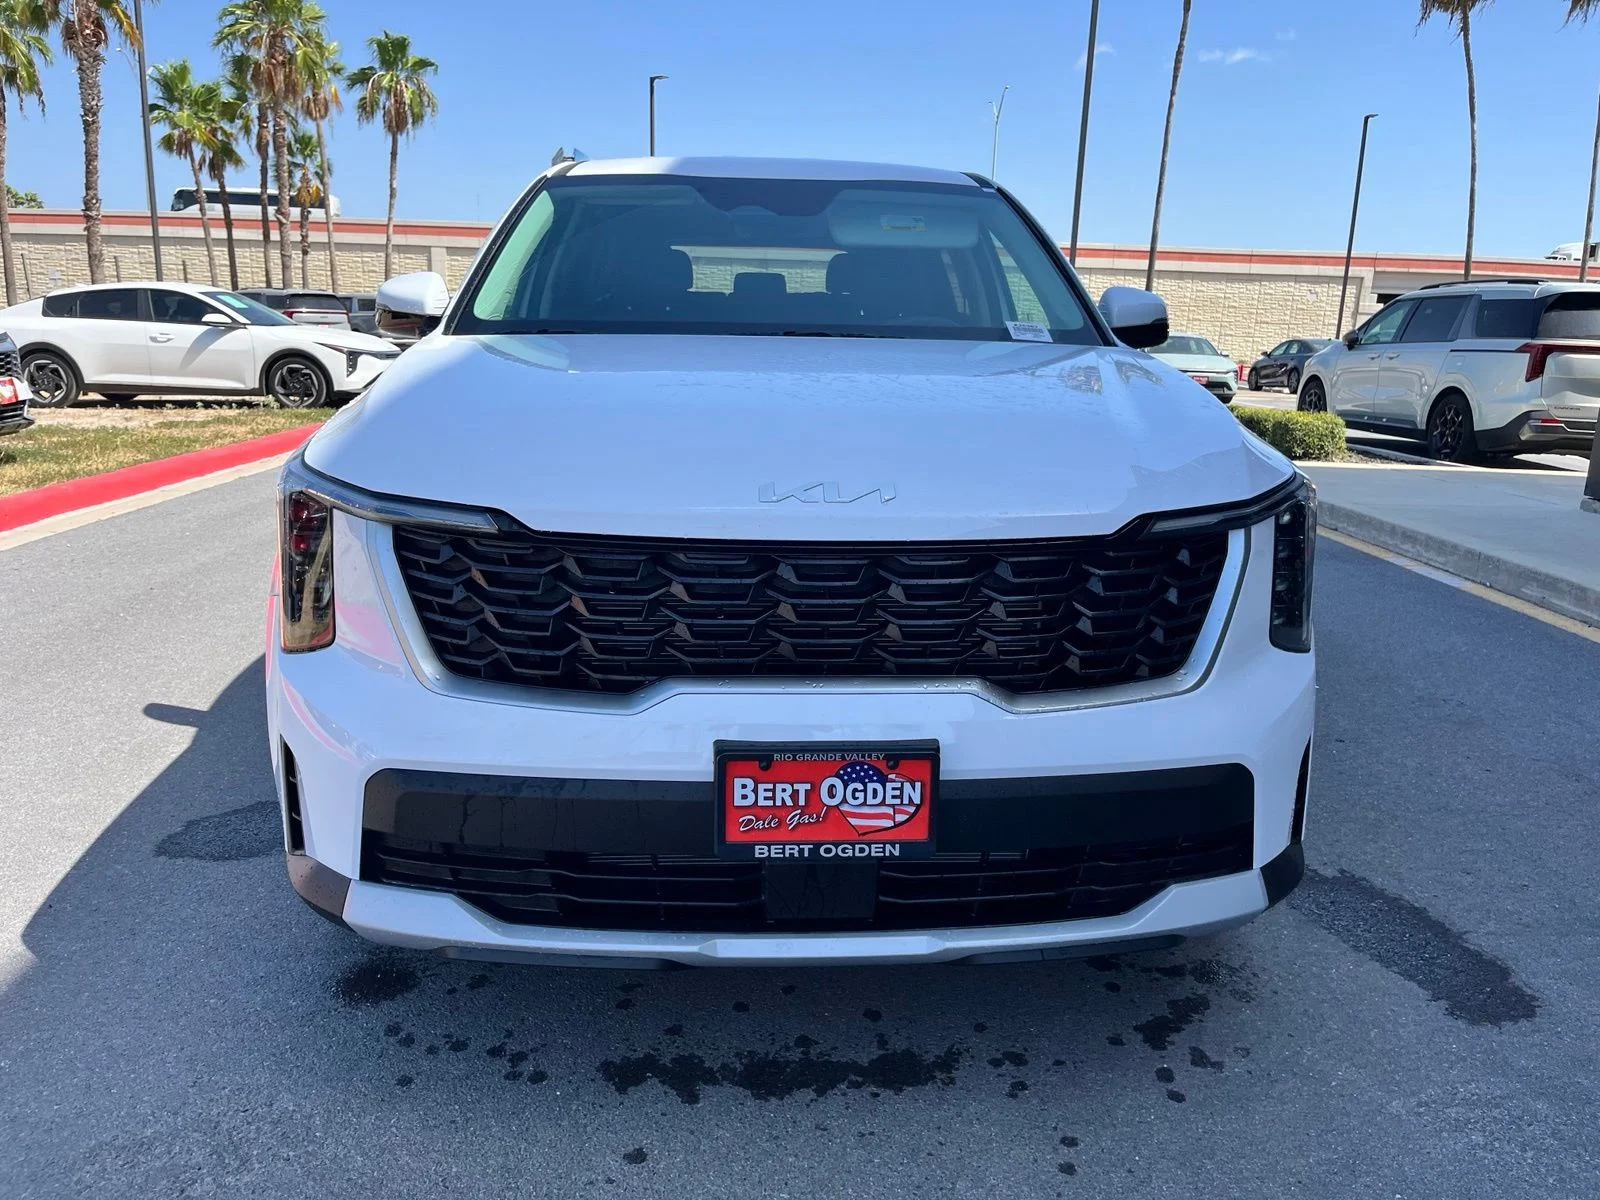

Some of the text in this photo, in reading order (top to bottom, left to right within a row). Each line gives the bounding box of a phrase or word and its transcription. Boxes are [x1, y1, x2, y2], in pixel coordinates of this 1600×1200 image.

[773, 753, 885, 761] RIO GRANDE VALLEY
[733, 776, 922, 807] BERT OGDEN
[739, 806, 827, 831] Dale Gas!
[754, 844, 900, 858] BERT OGDEN
